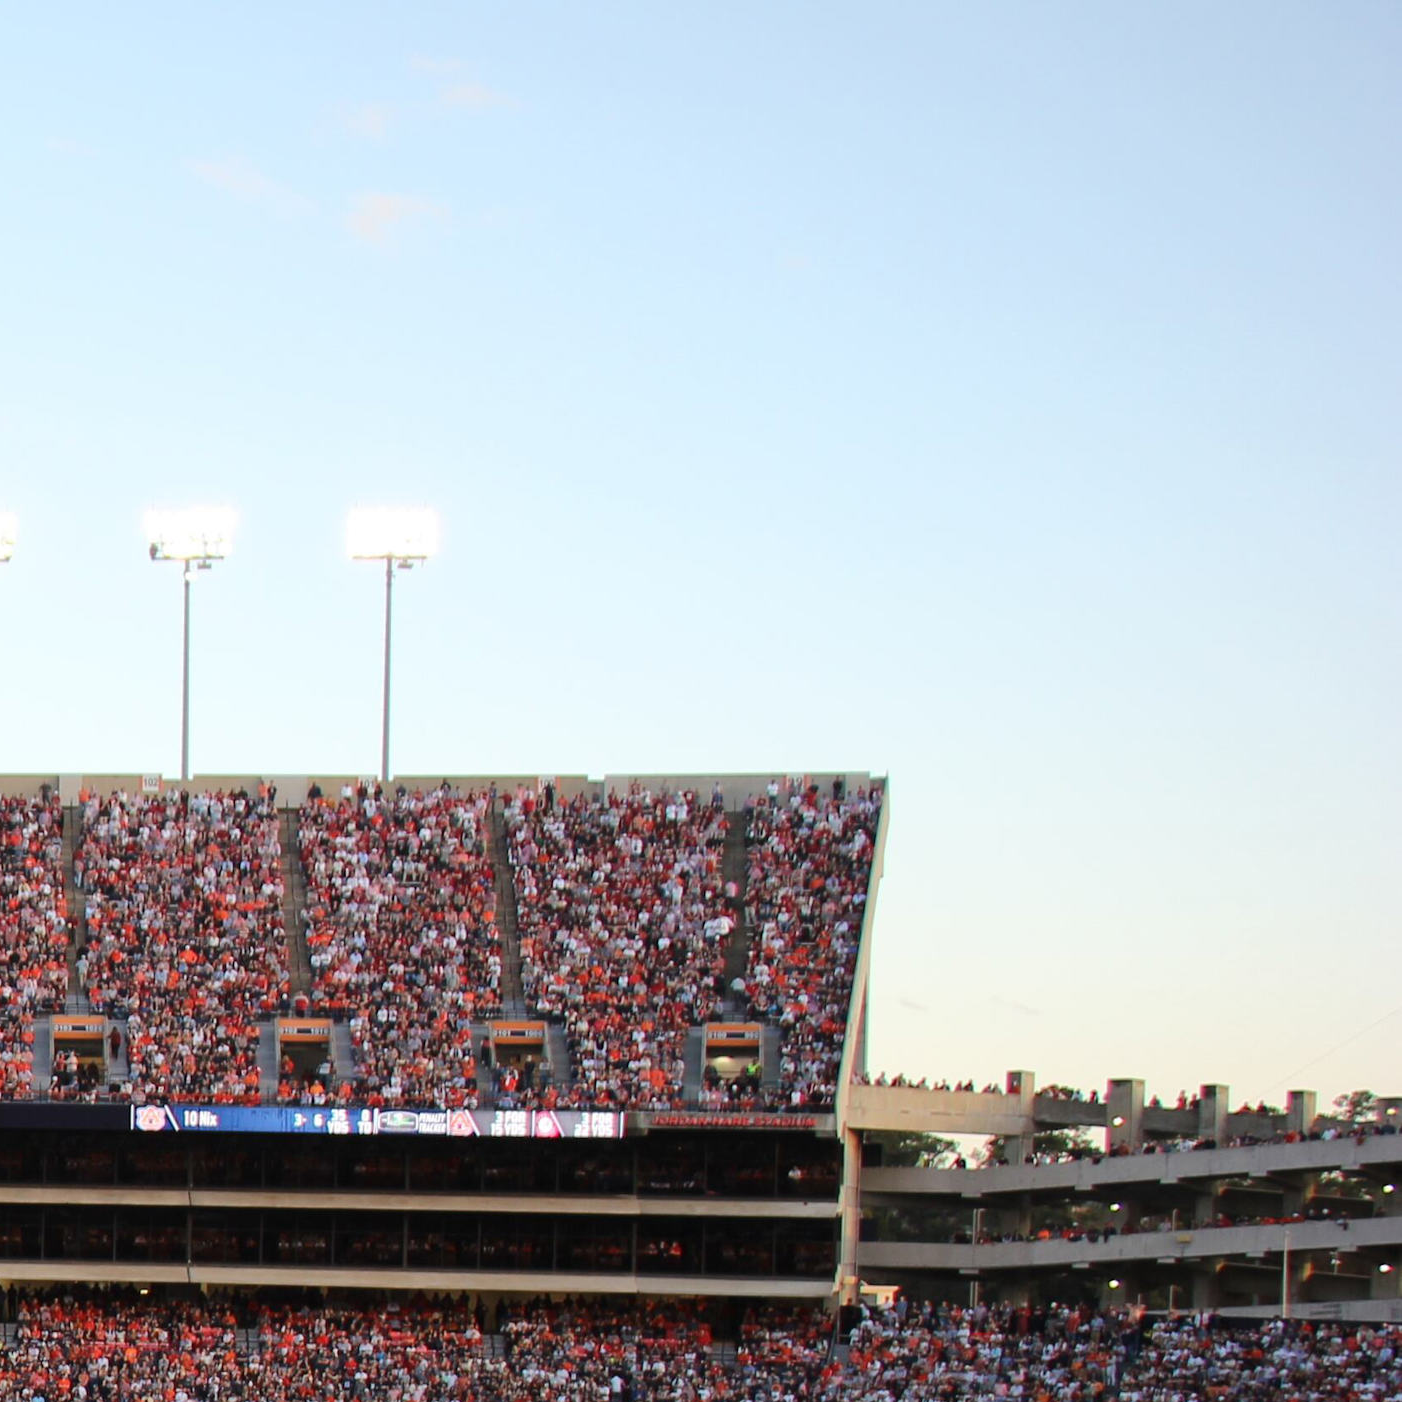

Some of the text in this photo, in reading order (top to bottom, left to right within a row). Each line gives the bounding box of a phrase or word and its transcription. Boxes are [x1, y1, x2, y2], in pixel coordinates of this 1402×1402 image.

[184, 1110, 324, 1127] 10 Nix 6
[331, 1108, 348, 1121] 35
[505, 1111, 527, 1123] FOR
[591, 1112, 613, 1124] FOR
[327, 1120, 351, 1134] YDS
[357, 1121, 372, 1135] TD
[418, 1123, 447, 1133] TRACKER
[752, 1116, 817, 1127] STADIUM
[505, 1123, 527, 1136] YDS
[591, 1124, 613, 1137] YDS
